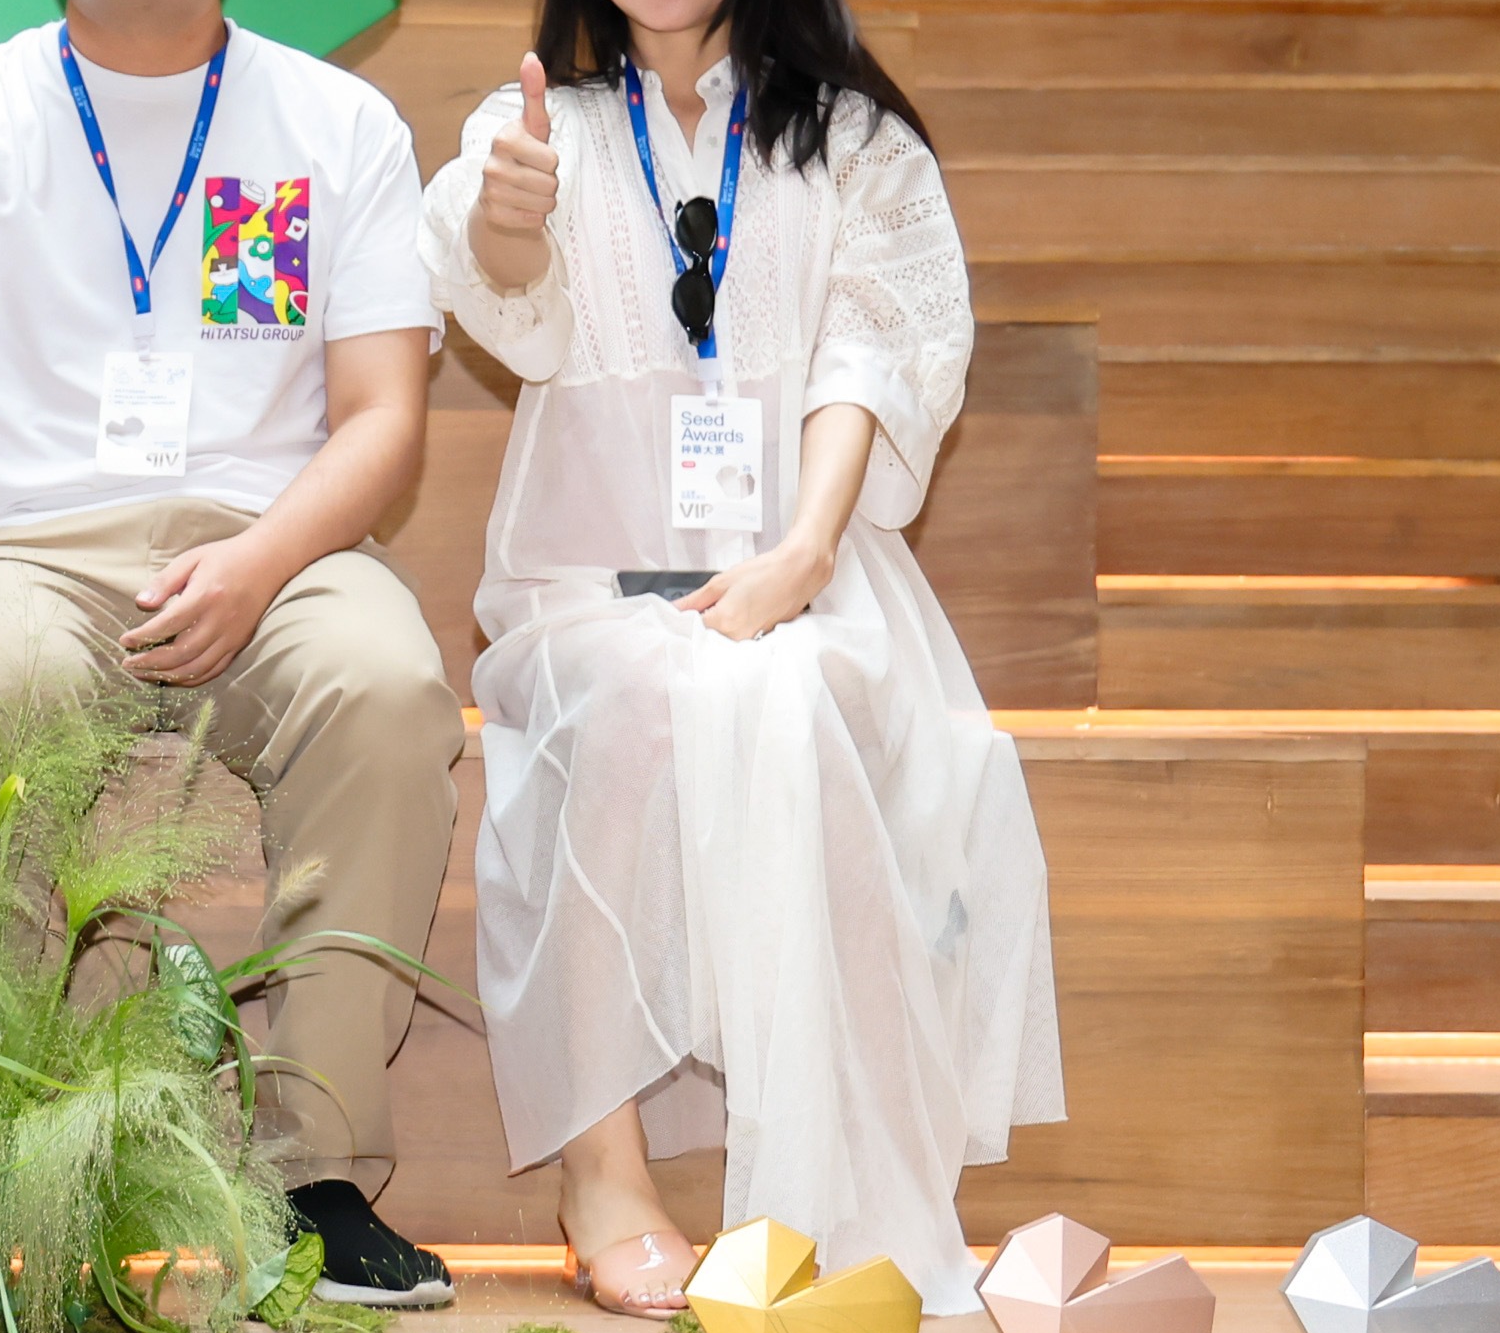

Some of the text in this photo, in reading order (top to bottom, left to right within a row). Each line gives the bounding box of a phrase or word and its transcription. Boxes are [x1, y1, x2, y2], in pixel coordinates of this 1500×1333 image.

[262, 328, 305, 341] GROUP
[681, 410, 725, 426] Seed
[681, 427, 744, 443] Awards
[679, 502, 714, 519] VIP
